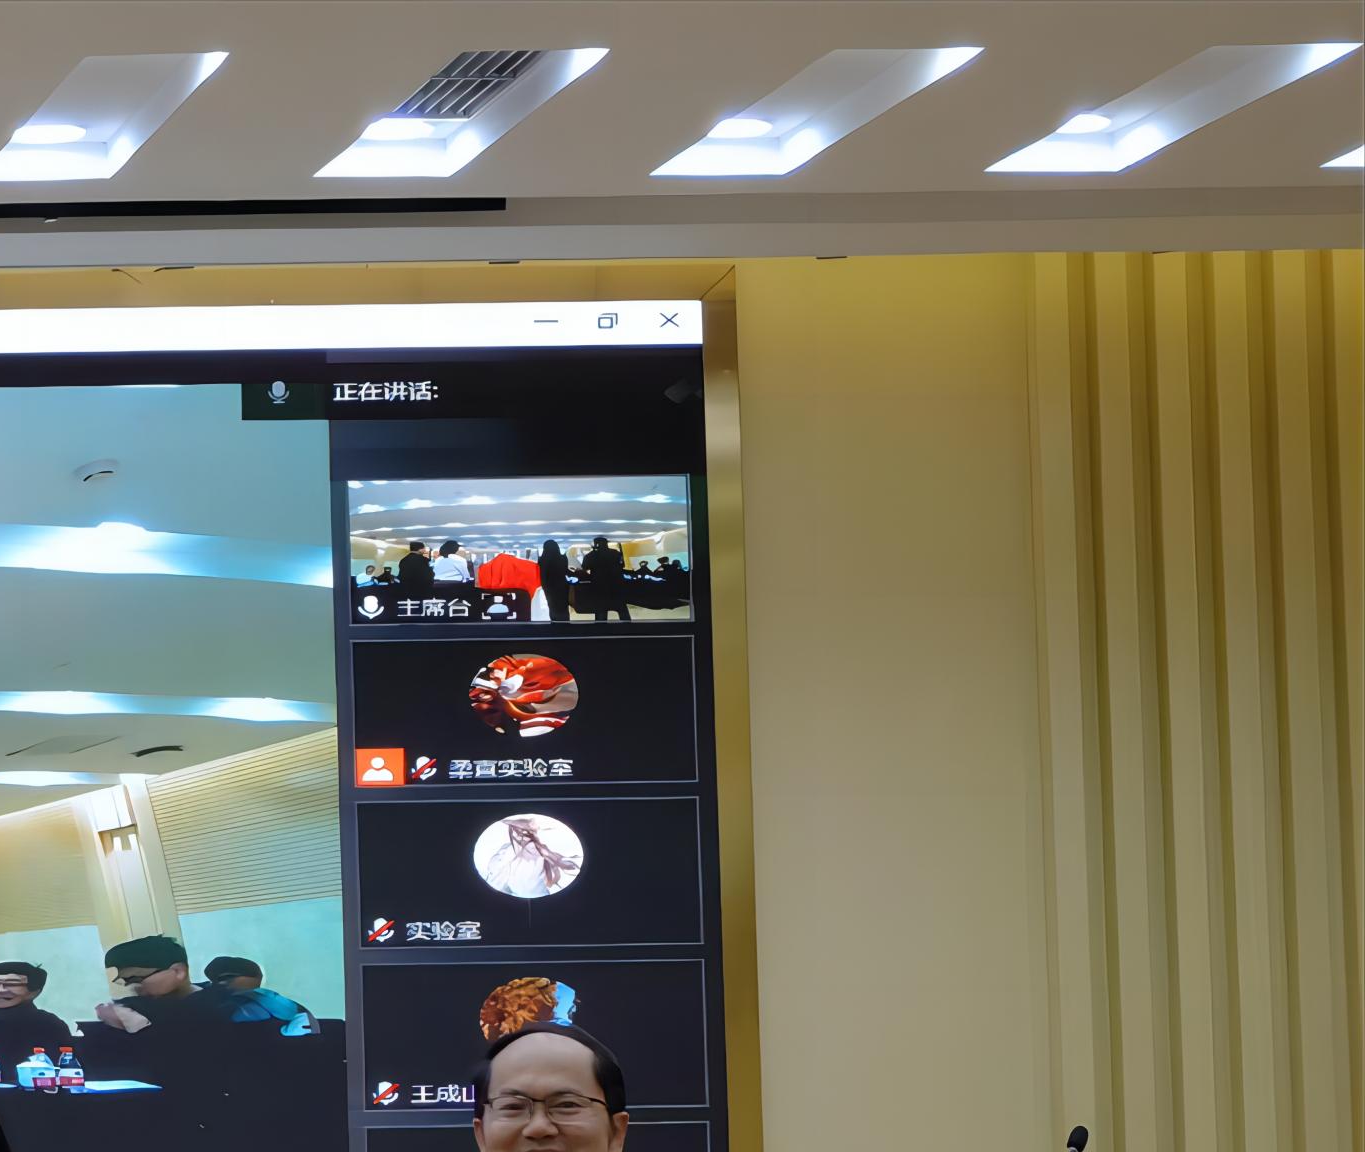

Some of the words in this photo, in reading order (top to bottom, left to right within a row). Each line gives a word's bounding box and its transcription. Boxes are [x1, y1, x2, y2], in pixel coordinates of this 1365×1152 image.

[333, 380, 439, 402] 正在讲话:
[397, 598, 471, 618] 主席台
[406, 921, 481, 941] 实验室
